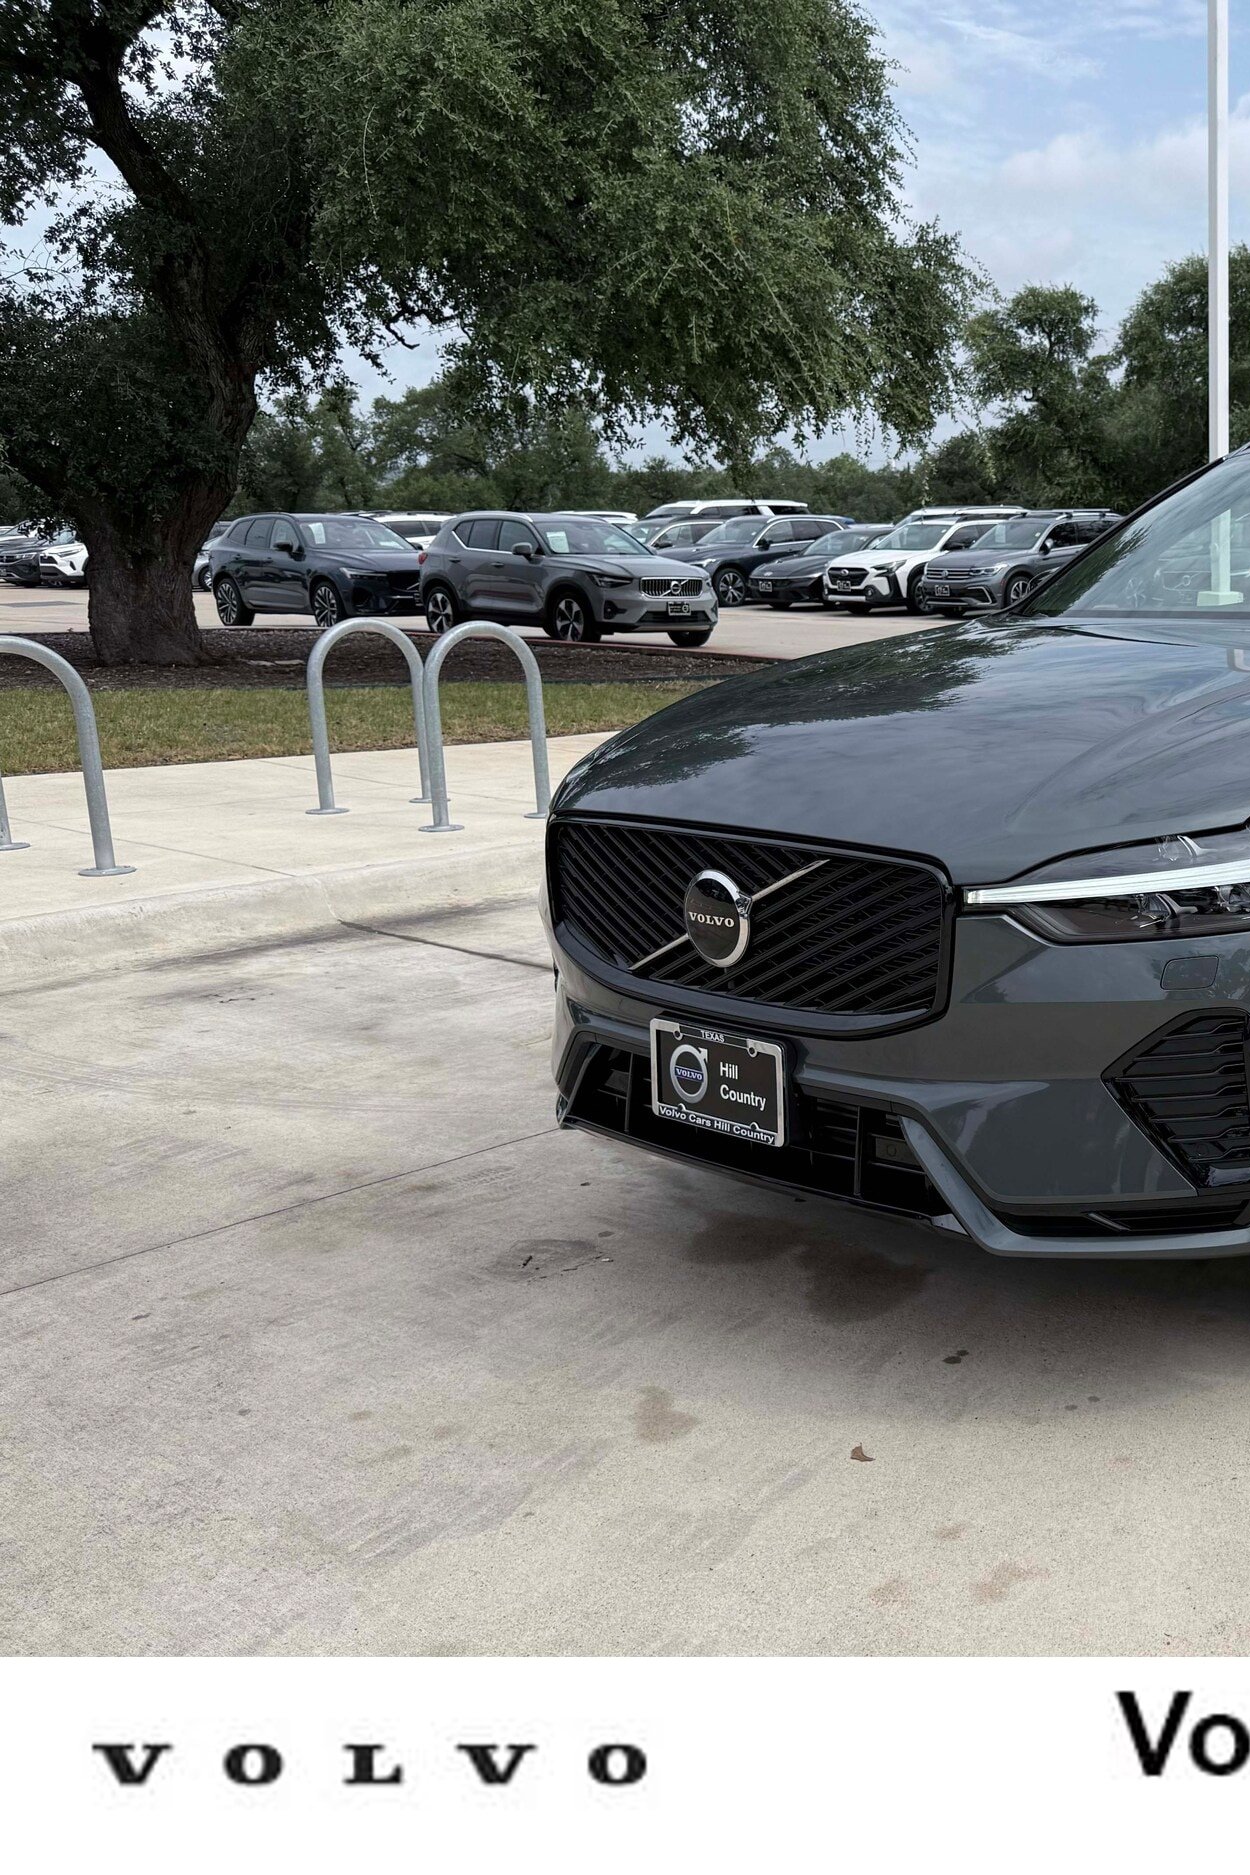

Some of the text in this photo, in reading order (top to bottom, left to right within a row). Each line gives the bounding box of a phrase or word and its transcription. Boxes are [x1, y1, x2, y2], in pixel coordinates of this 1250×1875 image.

[688, 911, 735, 928] VOLVO
[700, 1029, 725, 1043] TEXAS
[675, 1067, 703, 1081] VOLVO
[719, 1061, 739, 1080] Hill
[719, 1084, 767, 1112] Country
[659, 1105, 775, 1144] Volvo Cars Hill Country
